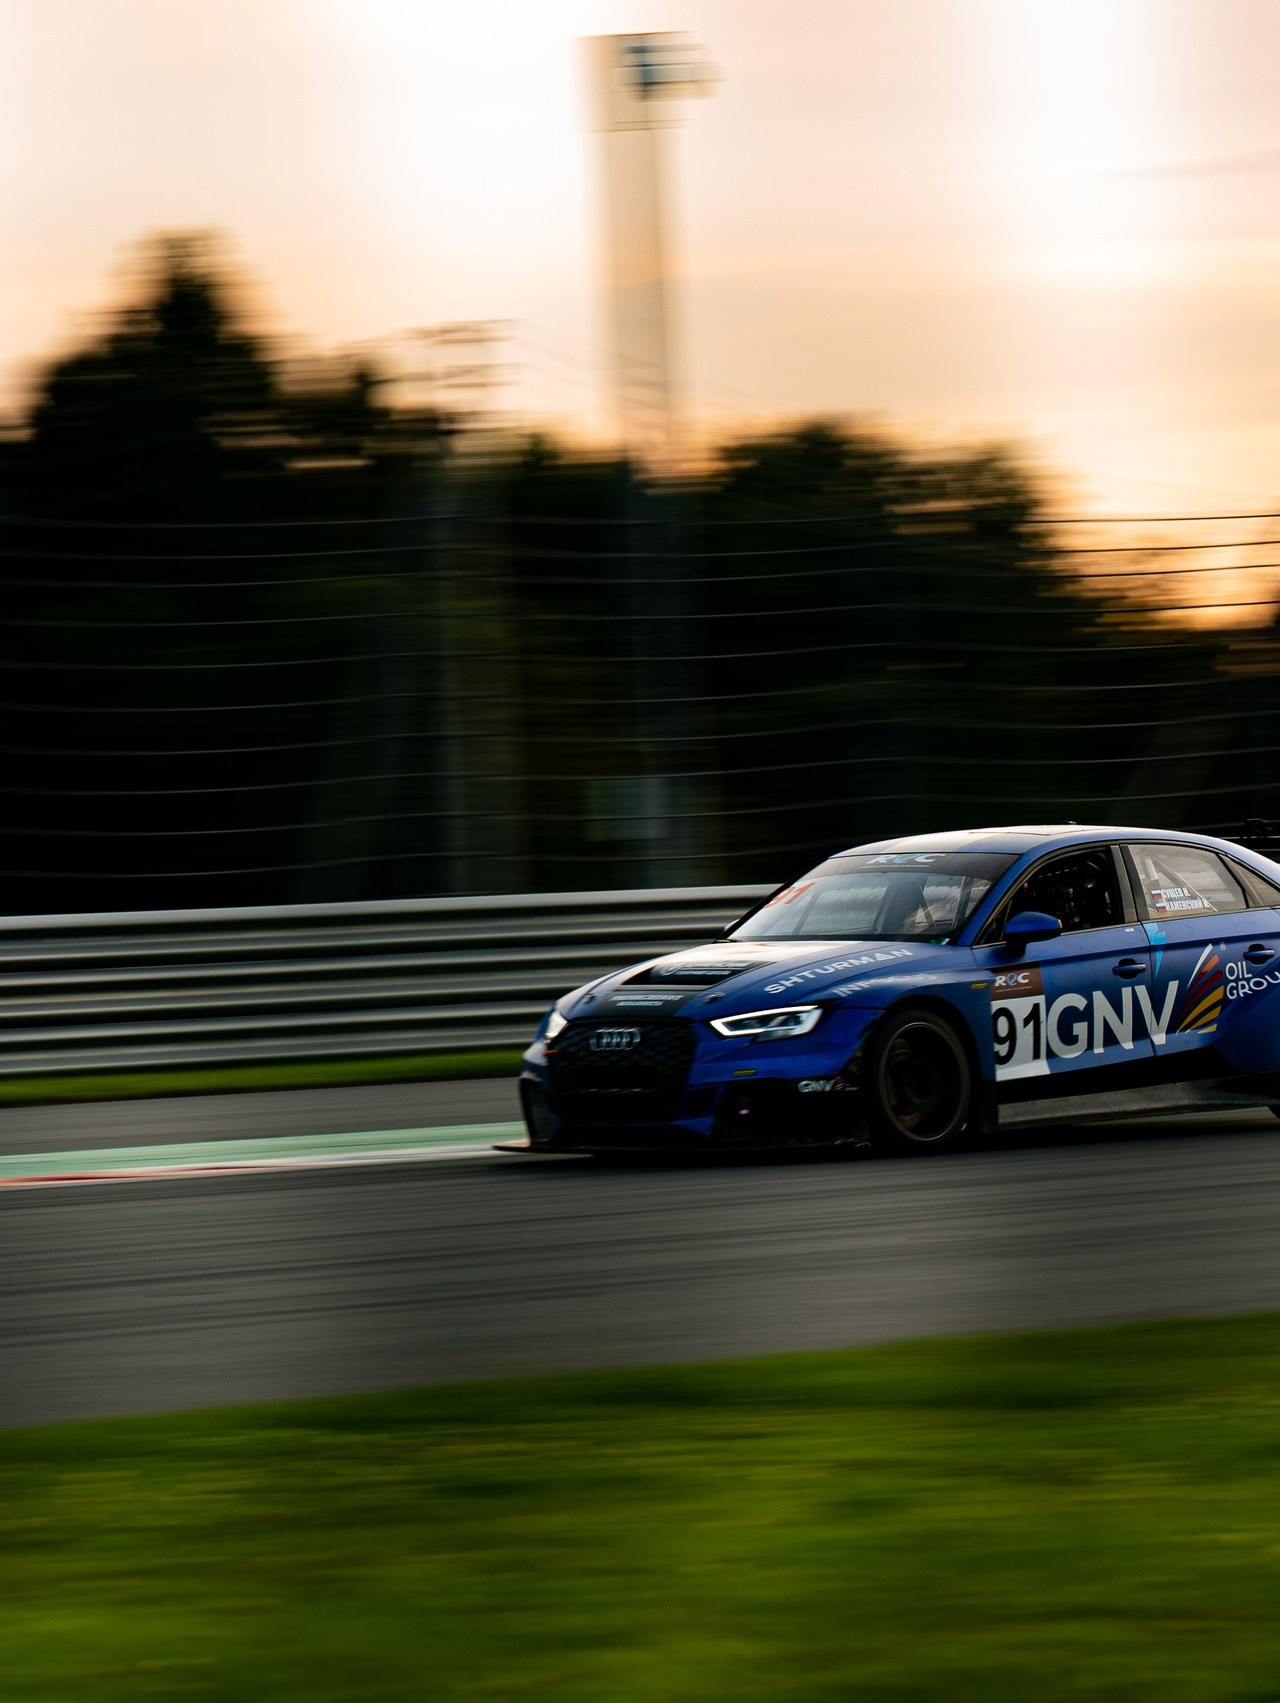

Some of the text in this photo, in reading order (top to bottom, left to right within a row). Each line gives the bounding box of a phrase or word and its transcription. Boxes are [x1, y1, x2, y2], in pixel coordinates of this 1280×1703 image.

[763, 949, 914, 994] SHTURMAN
[1225, 961, 1253, 980] OIL
[991, 1002, 1041, 1066] 91
[1047, 980, 1180, 1059] GNV
